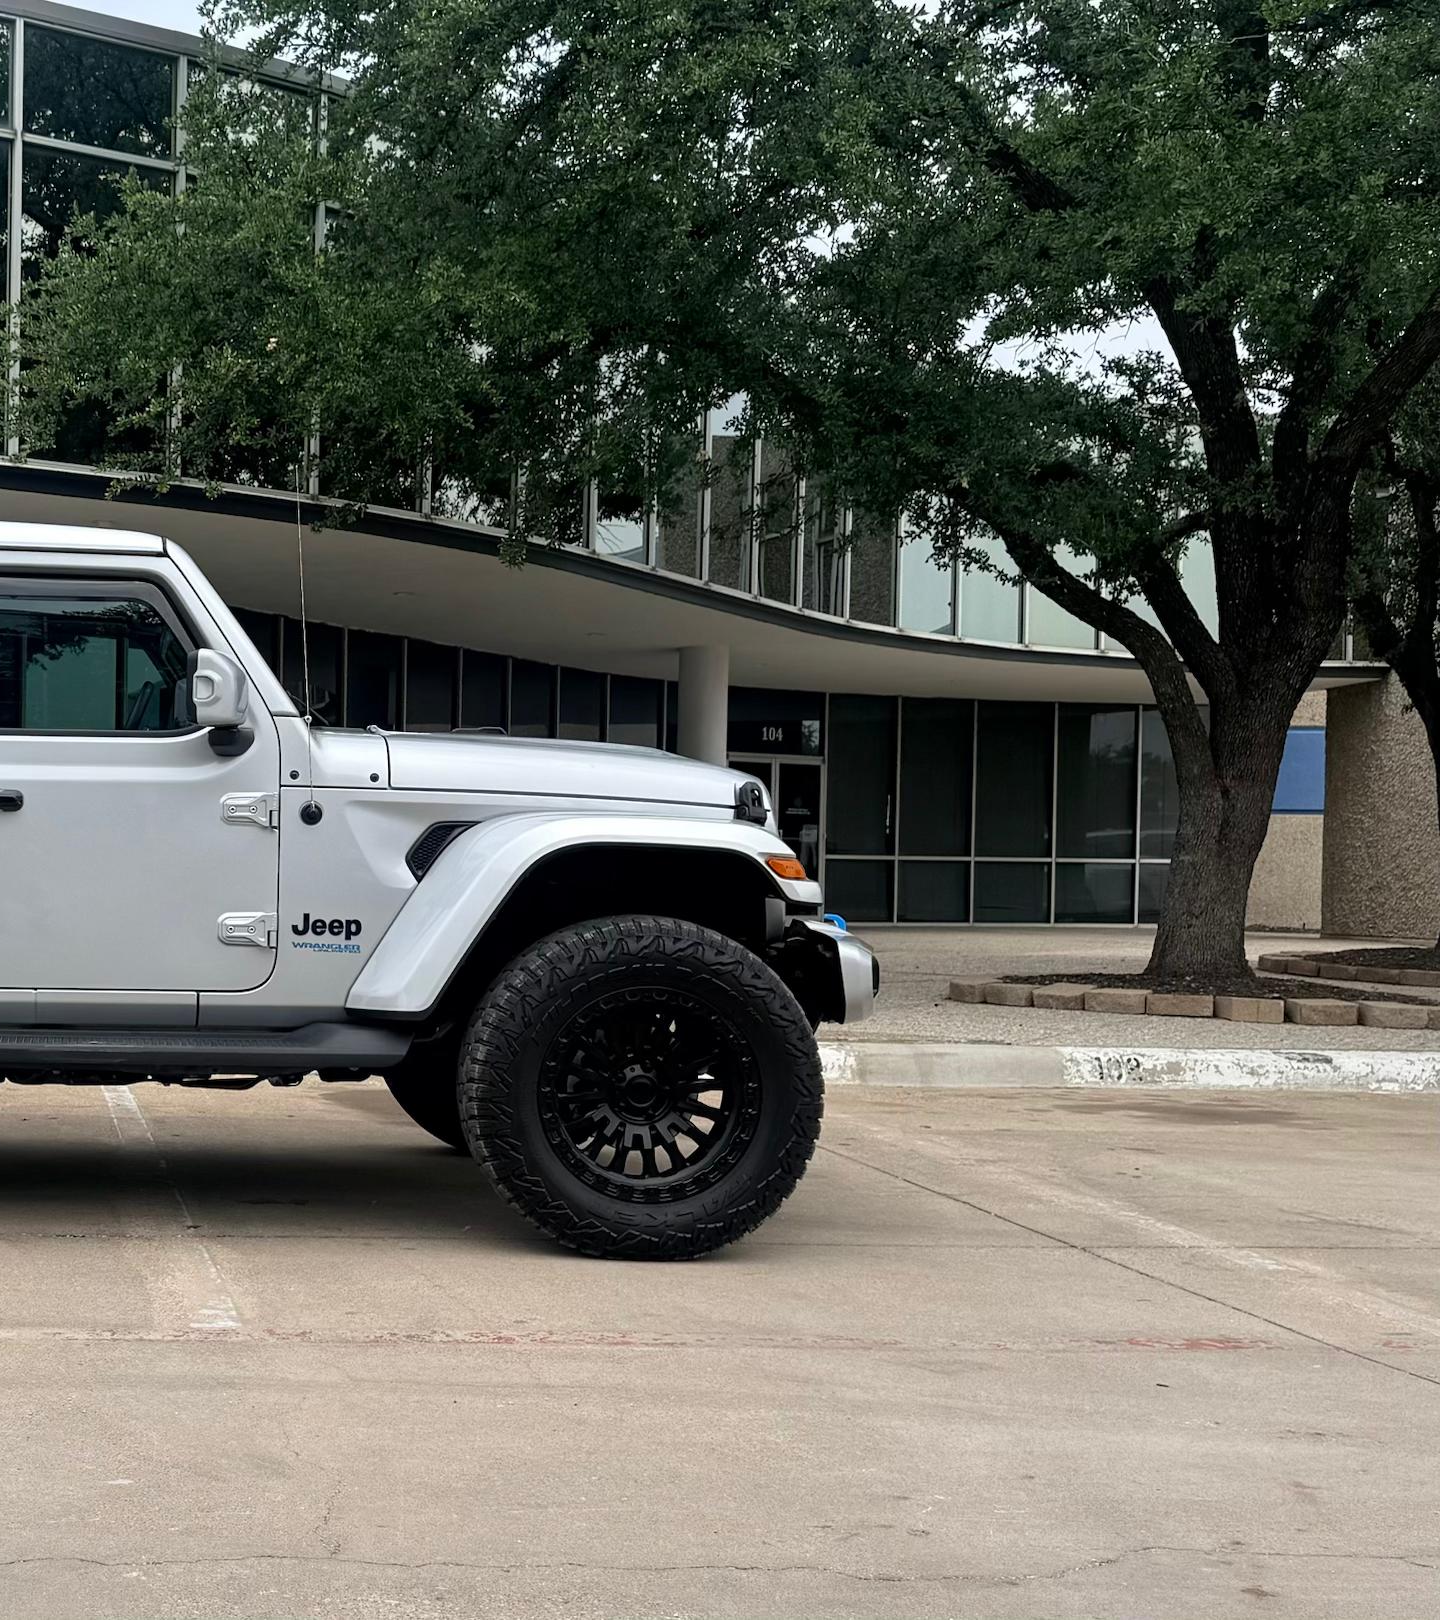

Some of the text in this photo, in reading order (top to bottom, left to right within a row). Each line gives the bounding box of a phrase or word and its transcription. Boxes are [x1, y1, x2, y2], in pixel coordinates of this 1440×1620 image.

[762, 726, 783, 741] 104
[291, 912, 362, 941] Jeep
[291, 941, 361, 951] WRANGLER
